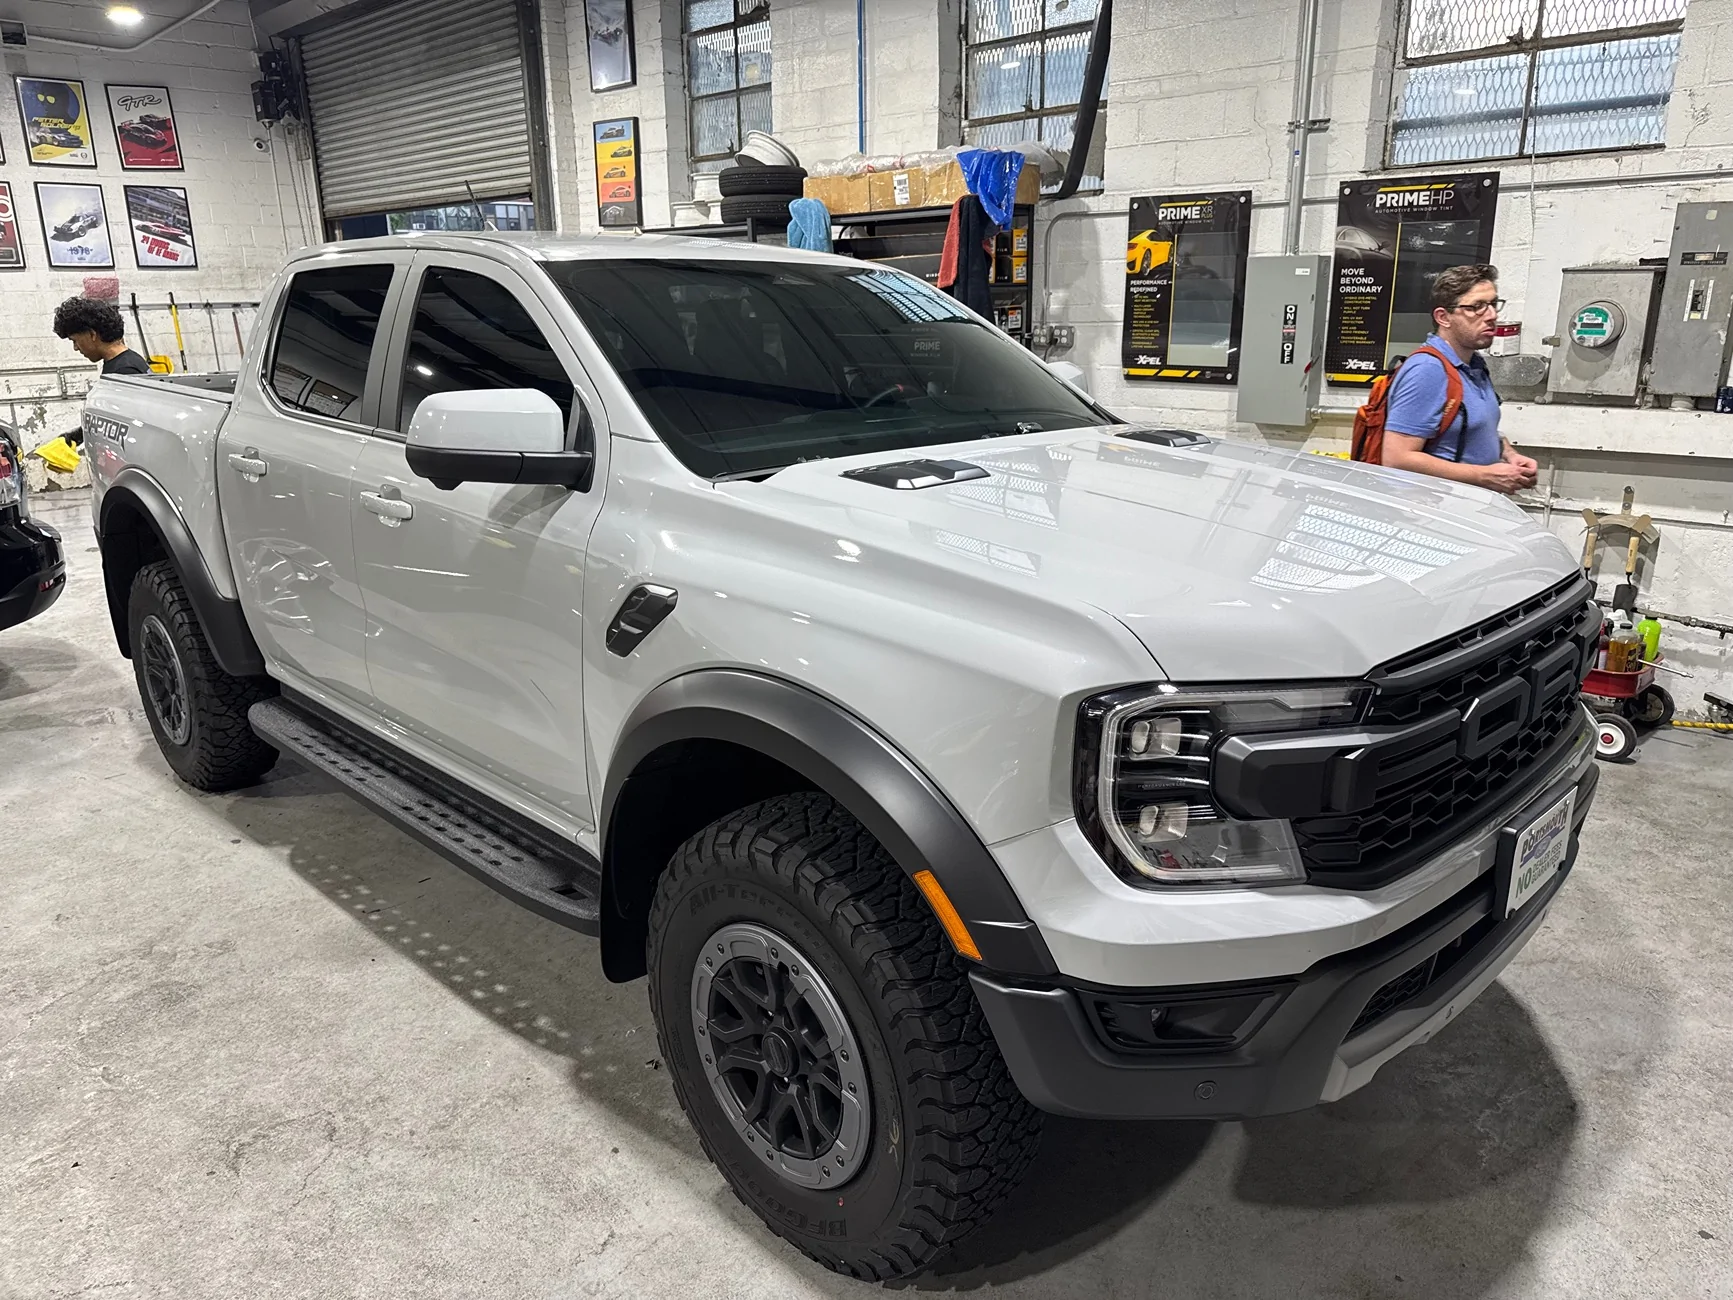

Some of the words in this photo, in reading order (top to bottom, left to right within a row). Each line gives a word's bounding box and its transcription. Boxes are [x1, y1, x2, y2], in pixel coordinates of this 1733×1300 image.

[1158, 206, 1200, 220] PRIME
[1201, 205, 1213, 214] XR
[1340, 267, 1365, 276] MOVE
[1340, 276, 1374, 285] BEYOND
[1339, 285, 1383, 294] ORDINARY
[1286, 305, 1296, 320] ON
[914, 341, 941, 351] PRIME
[1283, 342, 1293, 363] OFF
[1137, 354, 1162, 365] XPEL
[1345, 358, 1377, 370] XPEL
[84, 411, 129, 453] RAPTOR
[1515, 867, 1533, 898] NO
